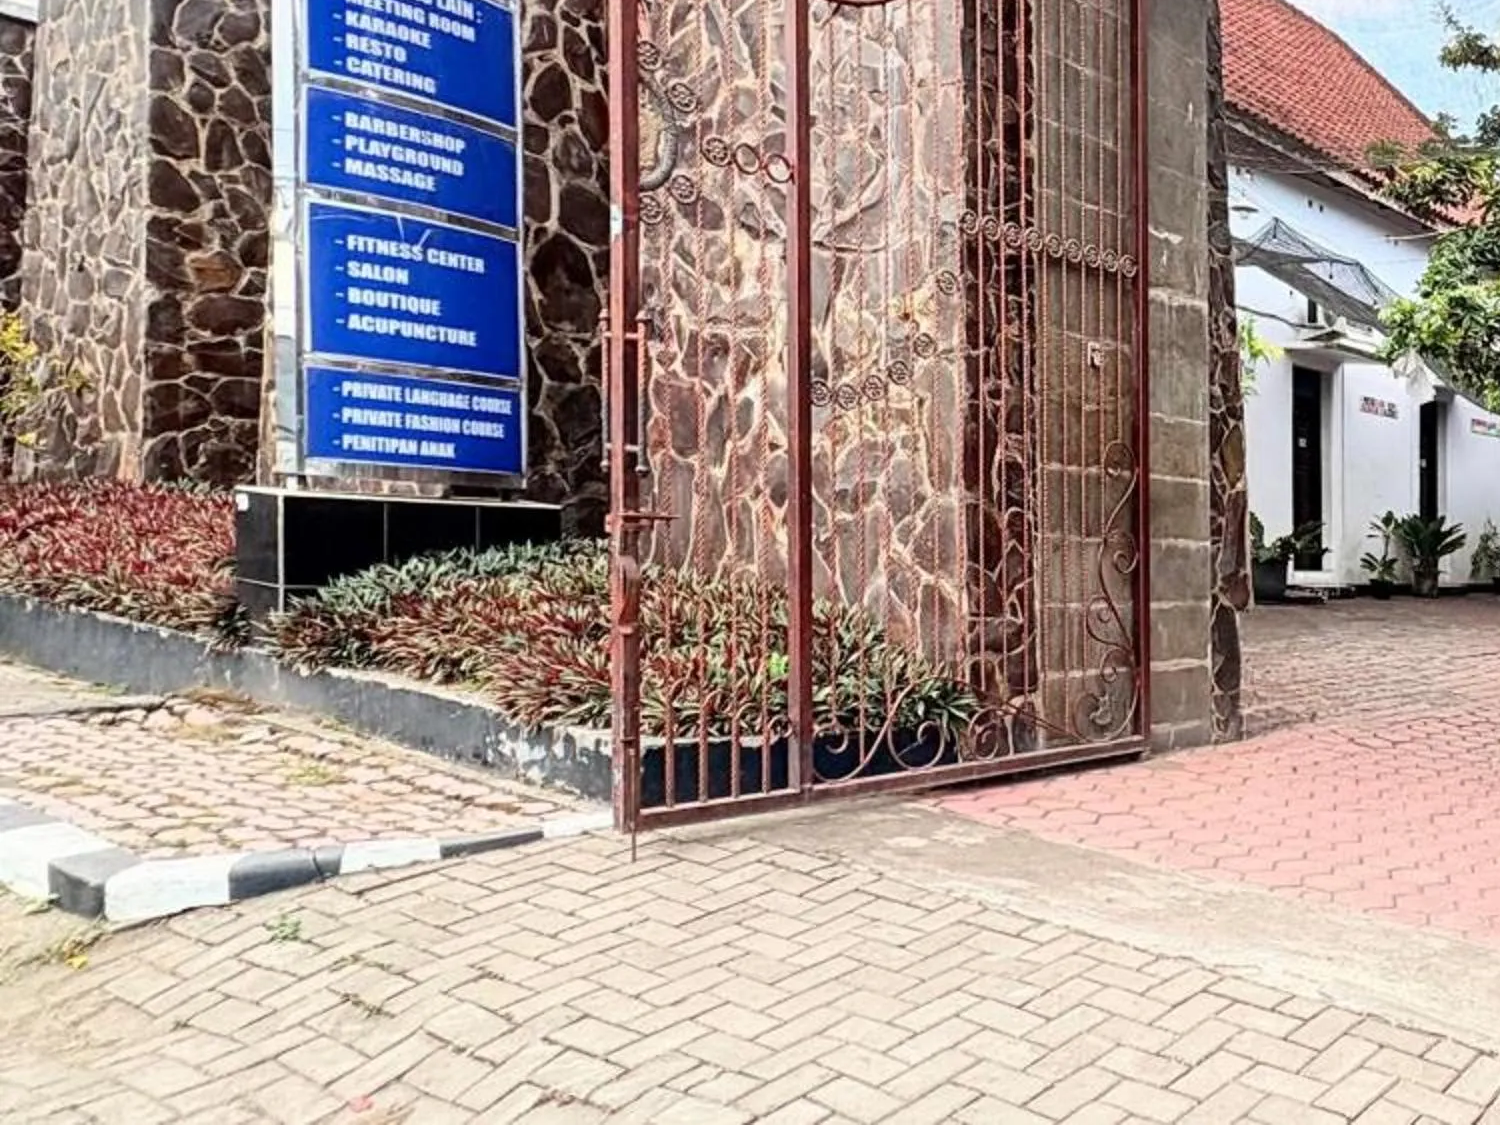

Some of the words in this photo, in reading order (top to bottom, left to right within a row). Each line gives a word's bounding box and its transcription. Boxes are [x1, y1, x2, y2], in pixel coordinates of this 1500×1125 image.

[345, 10, 432, 50] KARAOKE
[428, 12, 476, 43] ROOM
[345, 32, 407, 63] RESTO
[345, 55, 437, 95] CATERING
[344, 111, 467, 155] BARBERSHOP
[345, 134, 465, 177] PLAYGROUND
[344, 157, 437, 193] MASSAGE
[347, 234, 424, 263] FITNESS
[427, 248, 486, 275] CENTER
[347, 260, 410, 286] SALON
[347, 286, 442, 317] BOUTIQUE
[346, 313, 478, 347] ACUPUNCTURE
[341, 380, 403, 403] PRIVATE
[404, 386, 471, 411] LANGUAGE
[471, 395, 513, 416] COURSE
[341, 407, 403, 429] PRIVATE
[405, 412, 461, 435] FASHION
[462, 419, 505, 439] COURSE
[341, 434, 418, 456] PENITIPAN
[419, 439, 456, 460] ANAK
